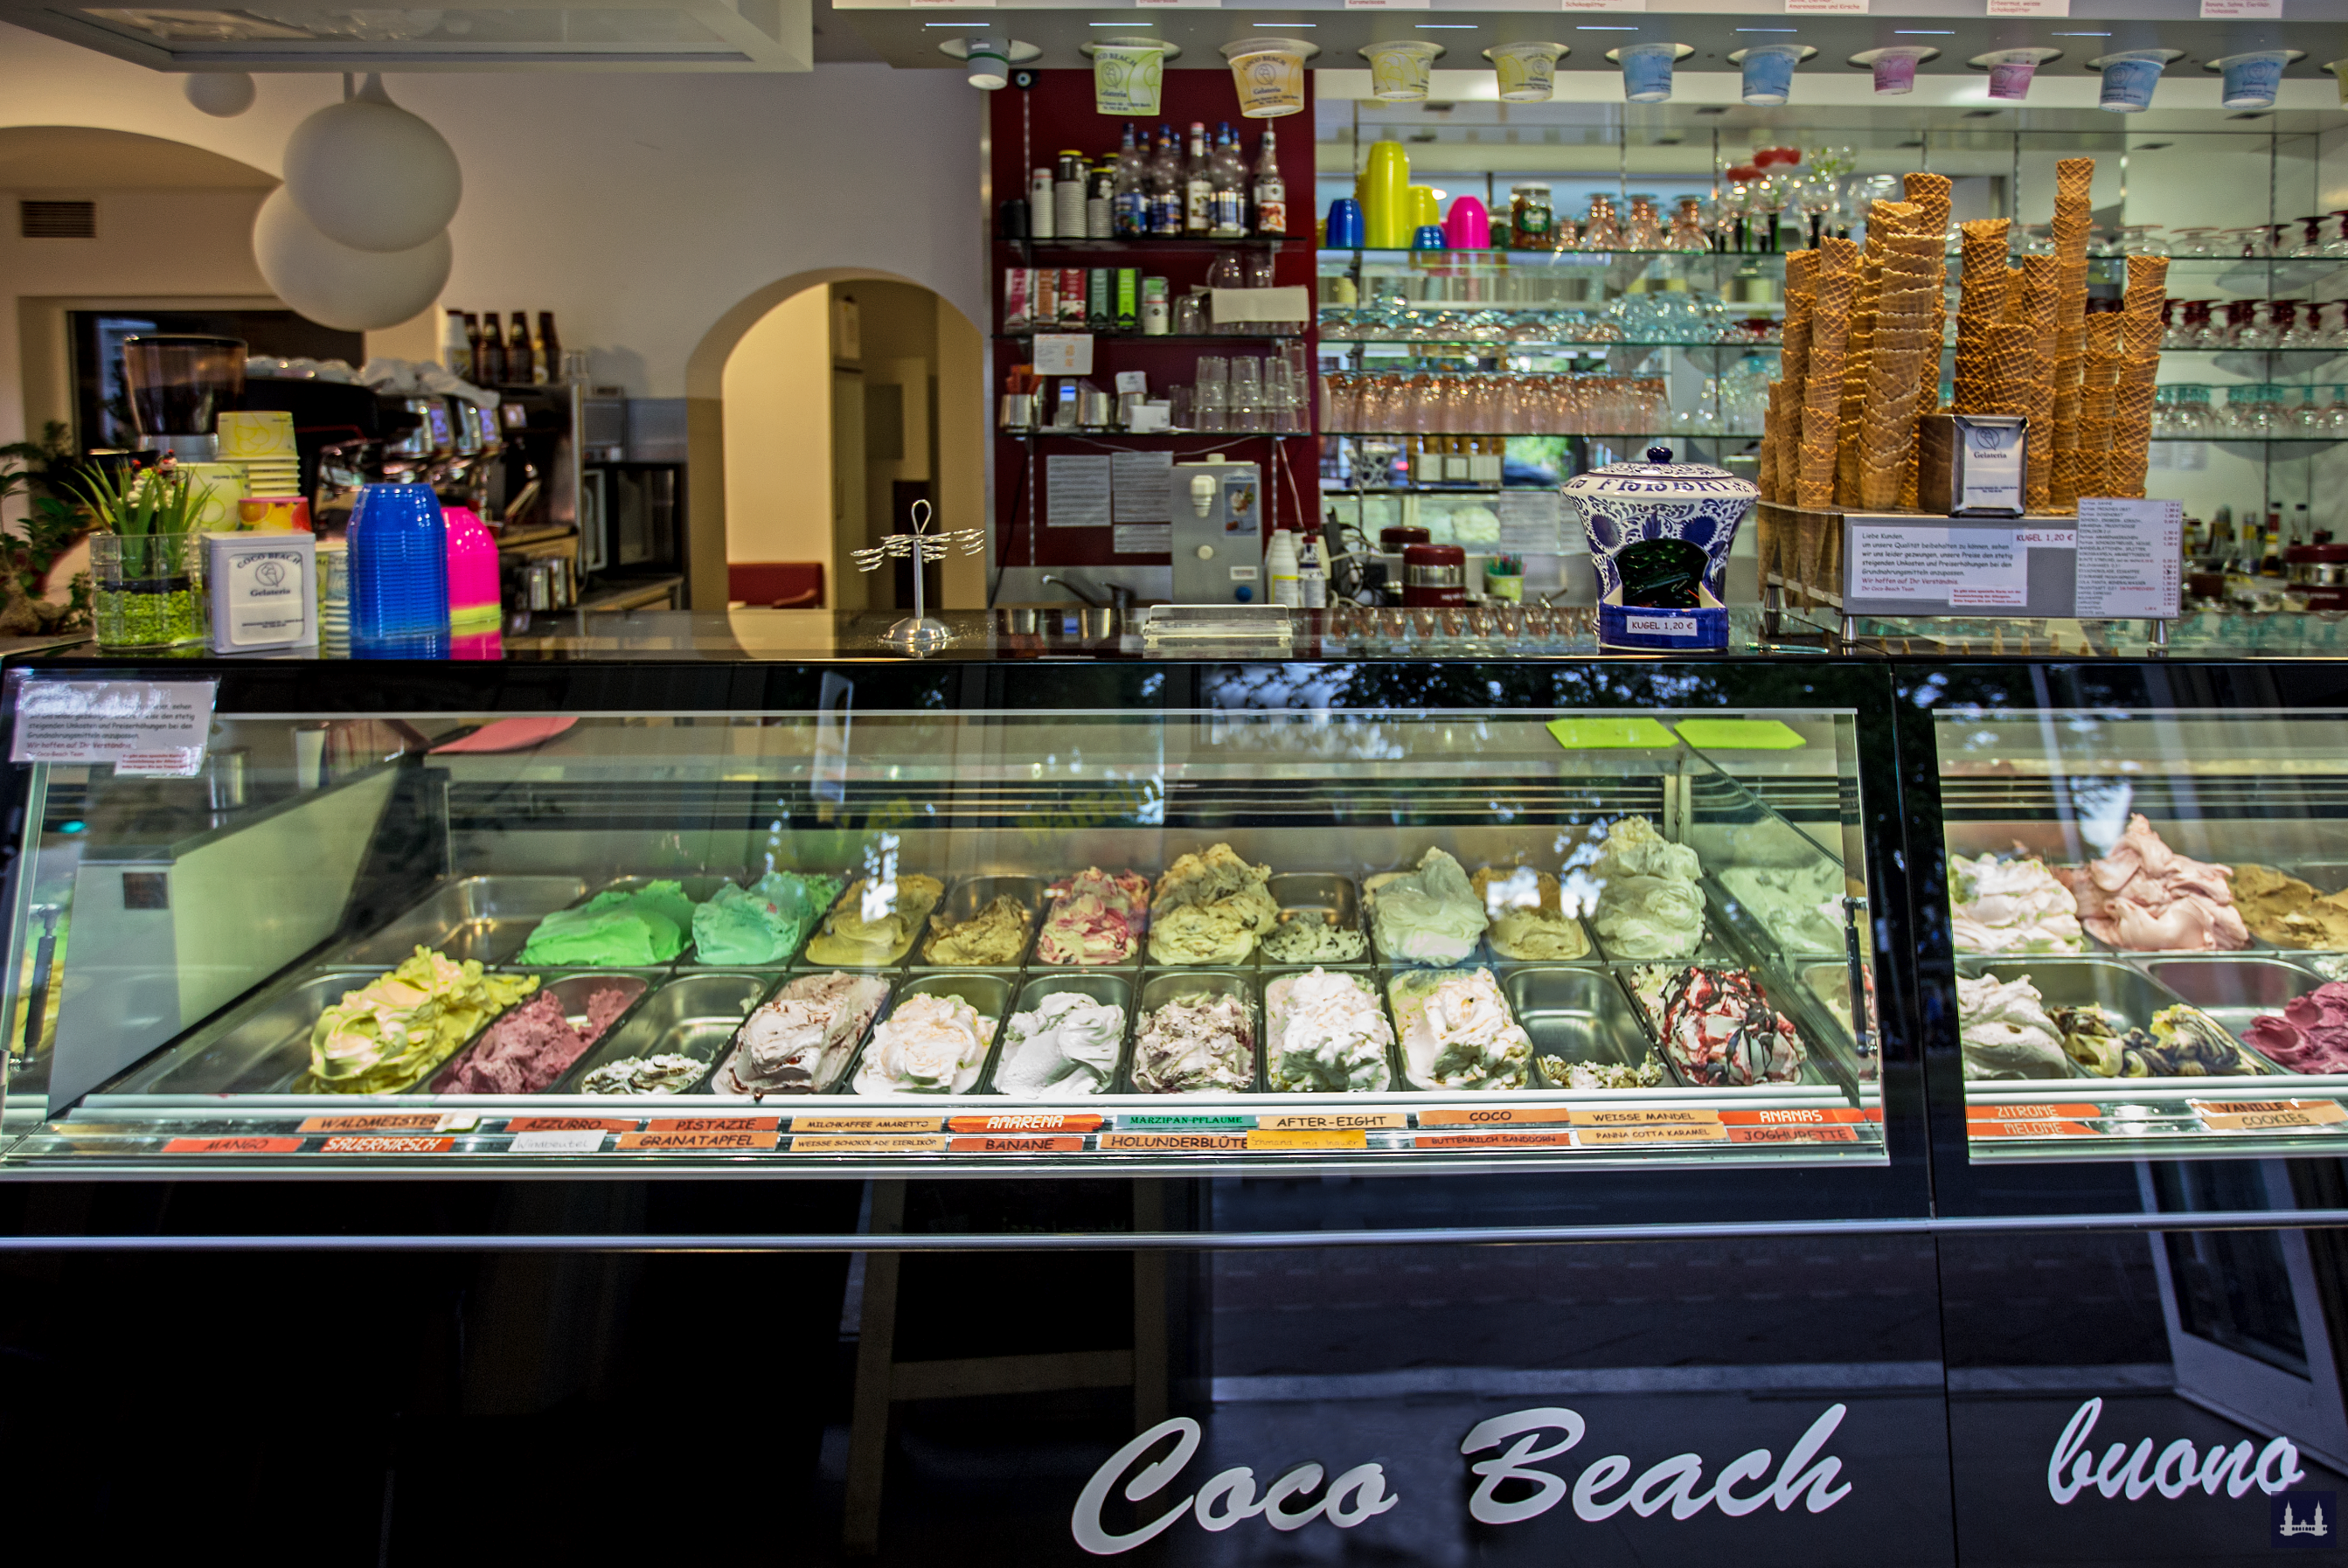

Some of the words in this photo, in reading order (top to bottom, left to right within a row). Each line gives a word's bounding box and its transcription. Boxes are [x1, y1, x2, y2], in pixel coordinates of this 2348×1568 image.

[237, 553, 266, 569] COCO
[267, 552, 302, 565] BEACH
[250, 588, 291, 597] Gelateria
[1664, 621, 1684, 631] 1,20
[2218, 1102, 2285, 1113] VANILLE
[987, 1114, 1065, 1130] AMARENA
[1129, 1116, 1244, 1126] MARZIPAN-PFLAUME
[1276, 1115, 1387, 1128] AFTER-EIGHT
[1469, 1111, 1512, 1121] COCO
[1593, 1113, 1643, 1123] WEISSE
[1646, 1112, 1696, 1122] MANDEL
[1759, 1109, 1824, 1123] ANANAS
[2241, 1114, 2310, 1126] COOKIES
[320, 1117, 440, 1129] WALDMEISTER
[524, 1120, 602, 1130] AZZURRO
[675, 1119, 756, 1131] PISTAZIE
[1595, 1130, 1629, 1139] PANNA
[1632, 1129, 1664, 1138] COTTA
[1664, 1127, 1710, 1137] KARAMEL
[1744, 1127, 1847, 1141] JOGHURETTE
[204, 1139, 269, 1152] MANGO
[517, 1138, 590, 1149] Windbeutel
[640, 1134, 756, 1148] GRANATAPFEL
[985, 1139, 1055, 1151] BANANE
[1111, 1135, 1247, 1149] HOLUNDERBLÜTE
[1251, 1136, 1293, 1146] Schmand
[1431, 1134, 1498, 1145] BUTTERMILCH
[1502, 1134, 1556, 1144] SANDDORN
[1072, 1417, 1399, 1555] Coco
[1460, 1403, 1852, 1524] Beach
[2048, 1397, 2306, 1505] buono
